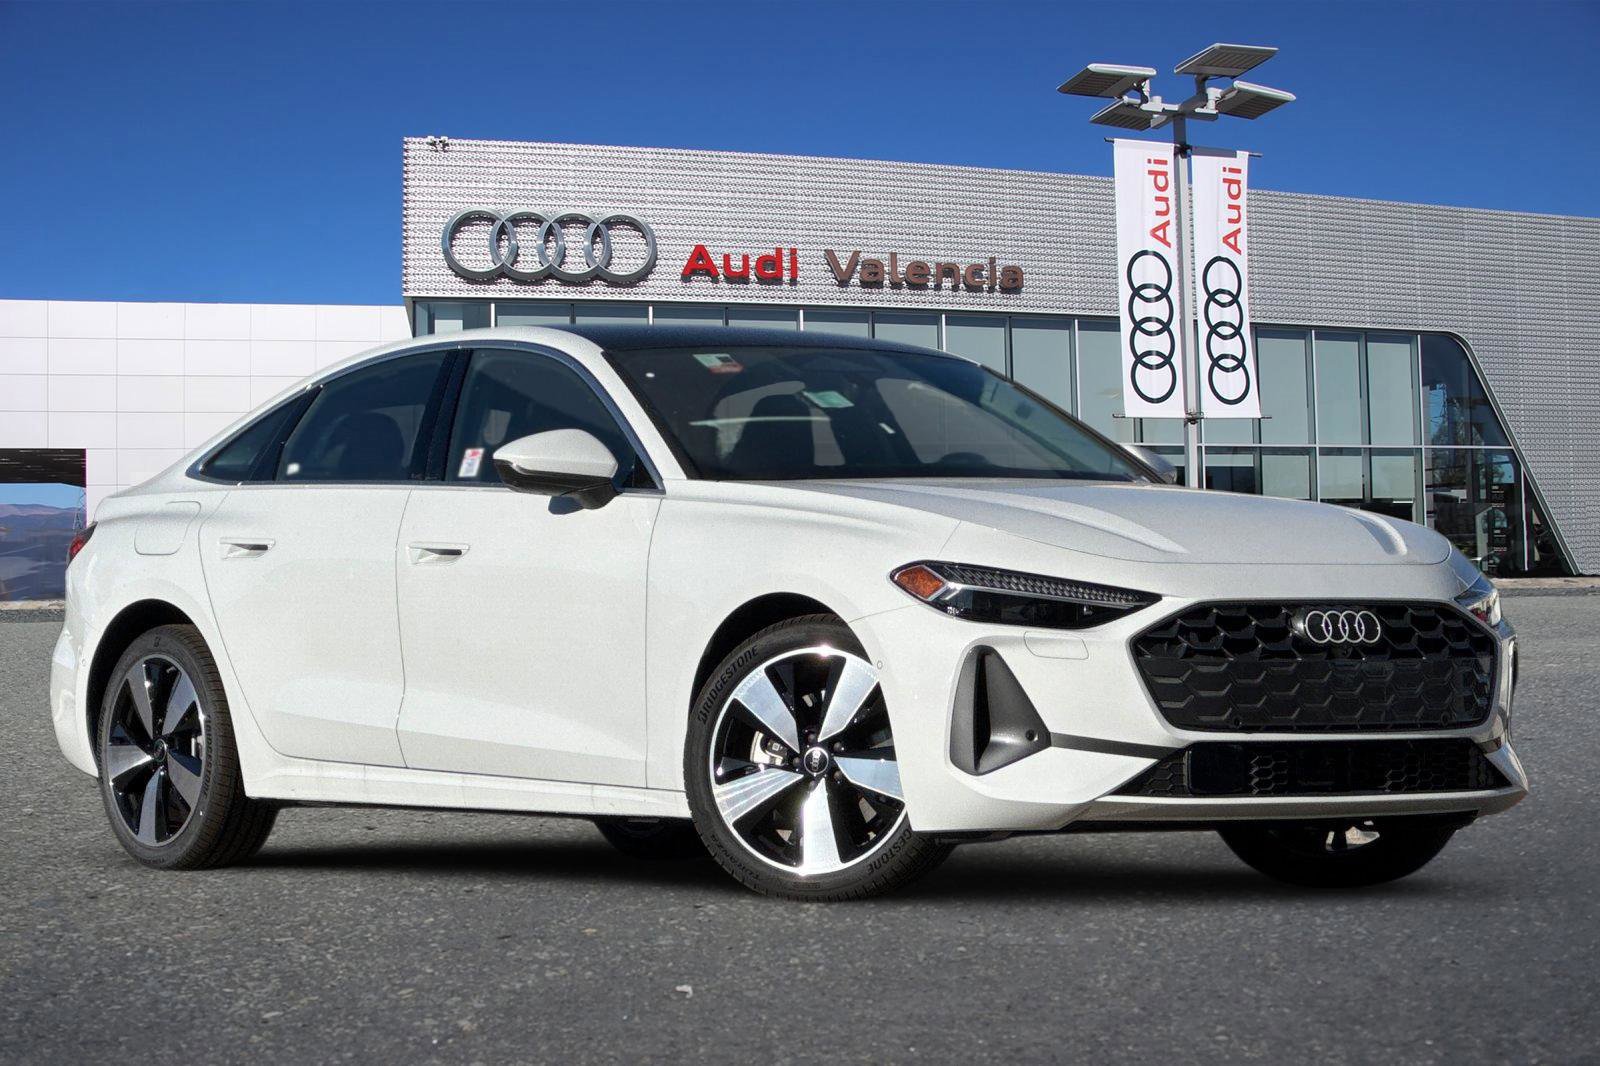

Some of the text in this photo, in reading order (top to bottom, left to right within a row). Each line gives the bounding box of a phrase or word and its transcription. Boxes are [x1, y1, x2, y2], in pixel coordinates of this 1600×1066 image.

[1147, 158, 1171, 249] Audi
[1222, 166, 1242, 256] Audi
[680, 244, 1025, 290] Audi Valencia
[697, 644, 759, 725] BRIDGESTONE
[865, 828, 912, 876] GESTONE
